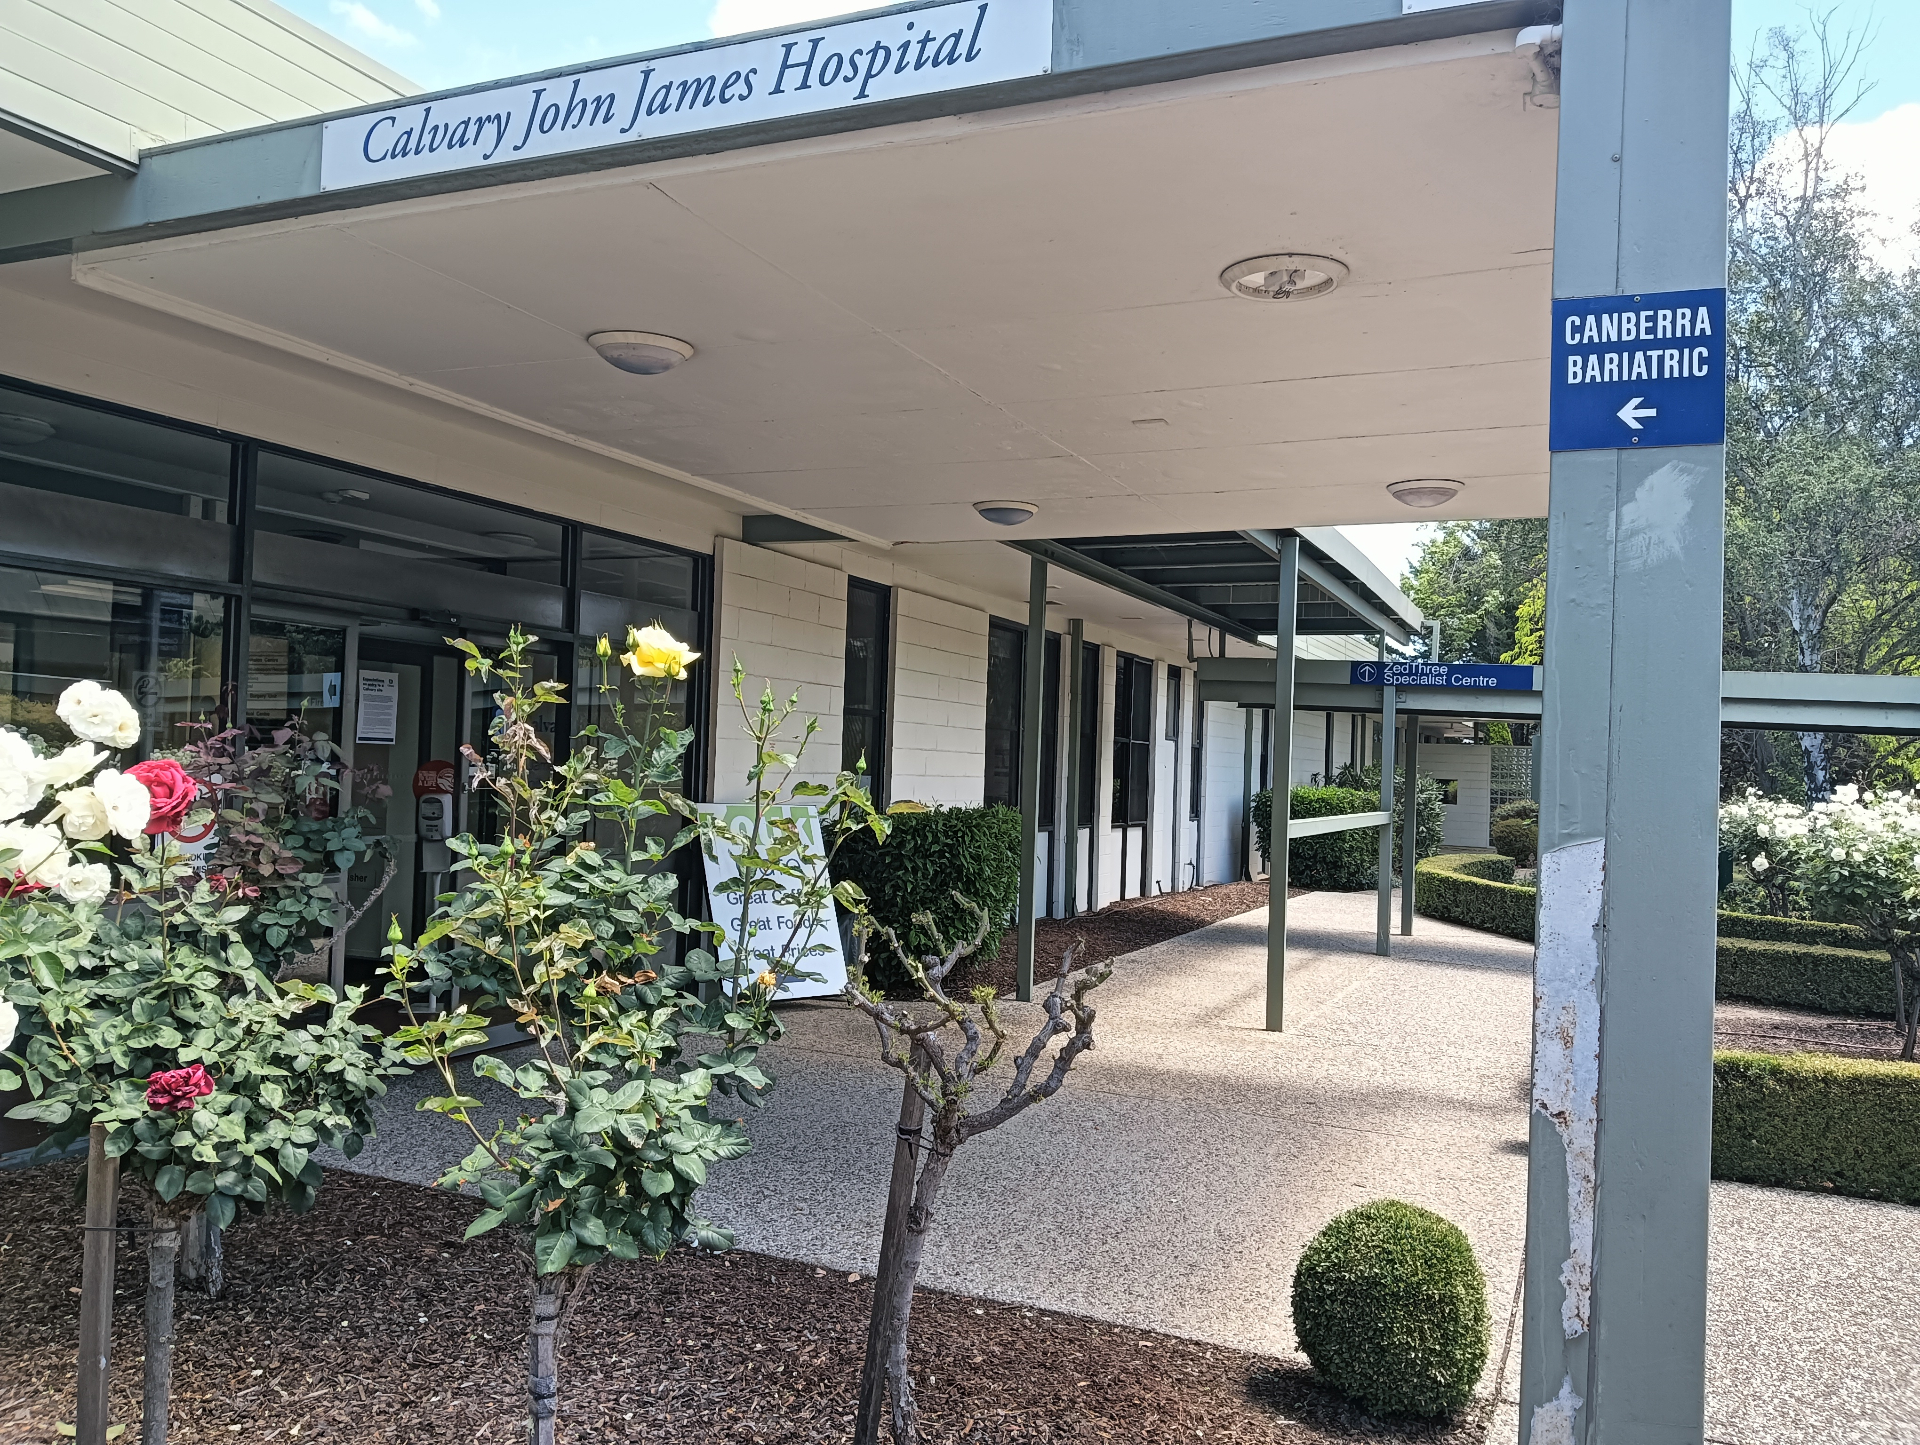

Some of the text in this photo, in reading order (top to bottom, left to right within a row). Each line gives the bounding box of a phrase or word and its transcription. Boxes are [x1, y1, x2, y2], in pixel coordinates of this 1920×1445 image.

[363, 3, 988, 163] Calvary John James Hospital
[1565, 306, 1712, 345] CANBERRA
[1567, 347, 1709, 384] BARIATRIC
[1384, 673, 1497, 687] Specialist Centre
[730, 916, 772, 932] Geat
